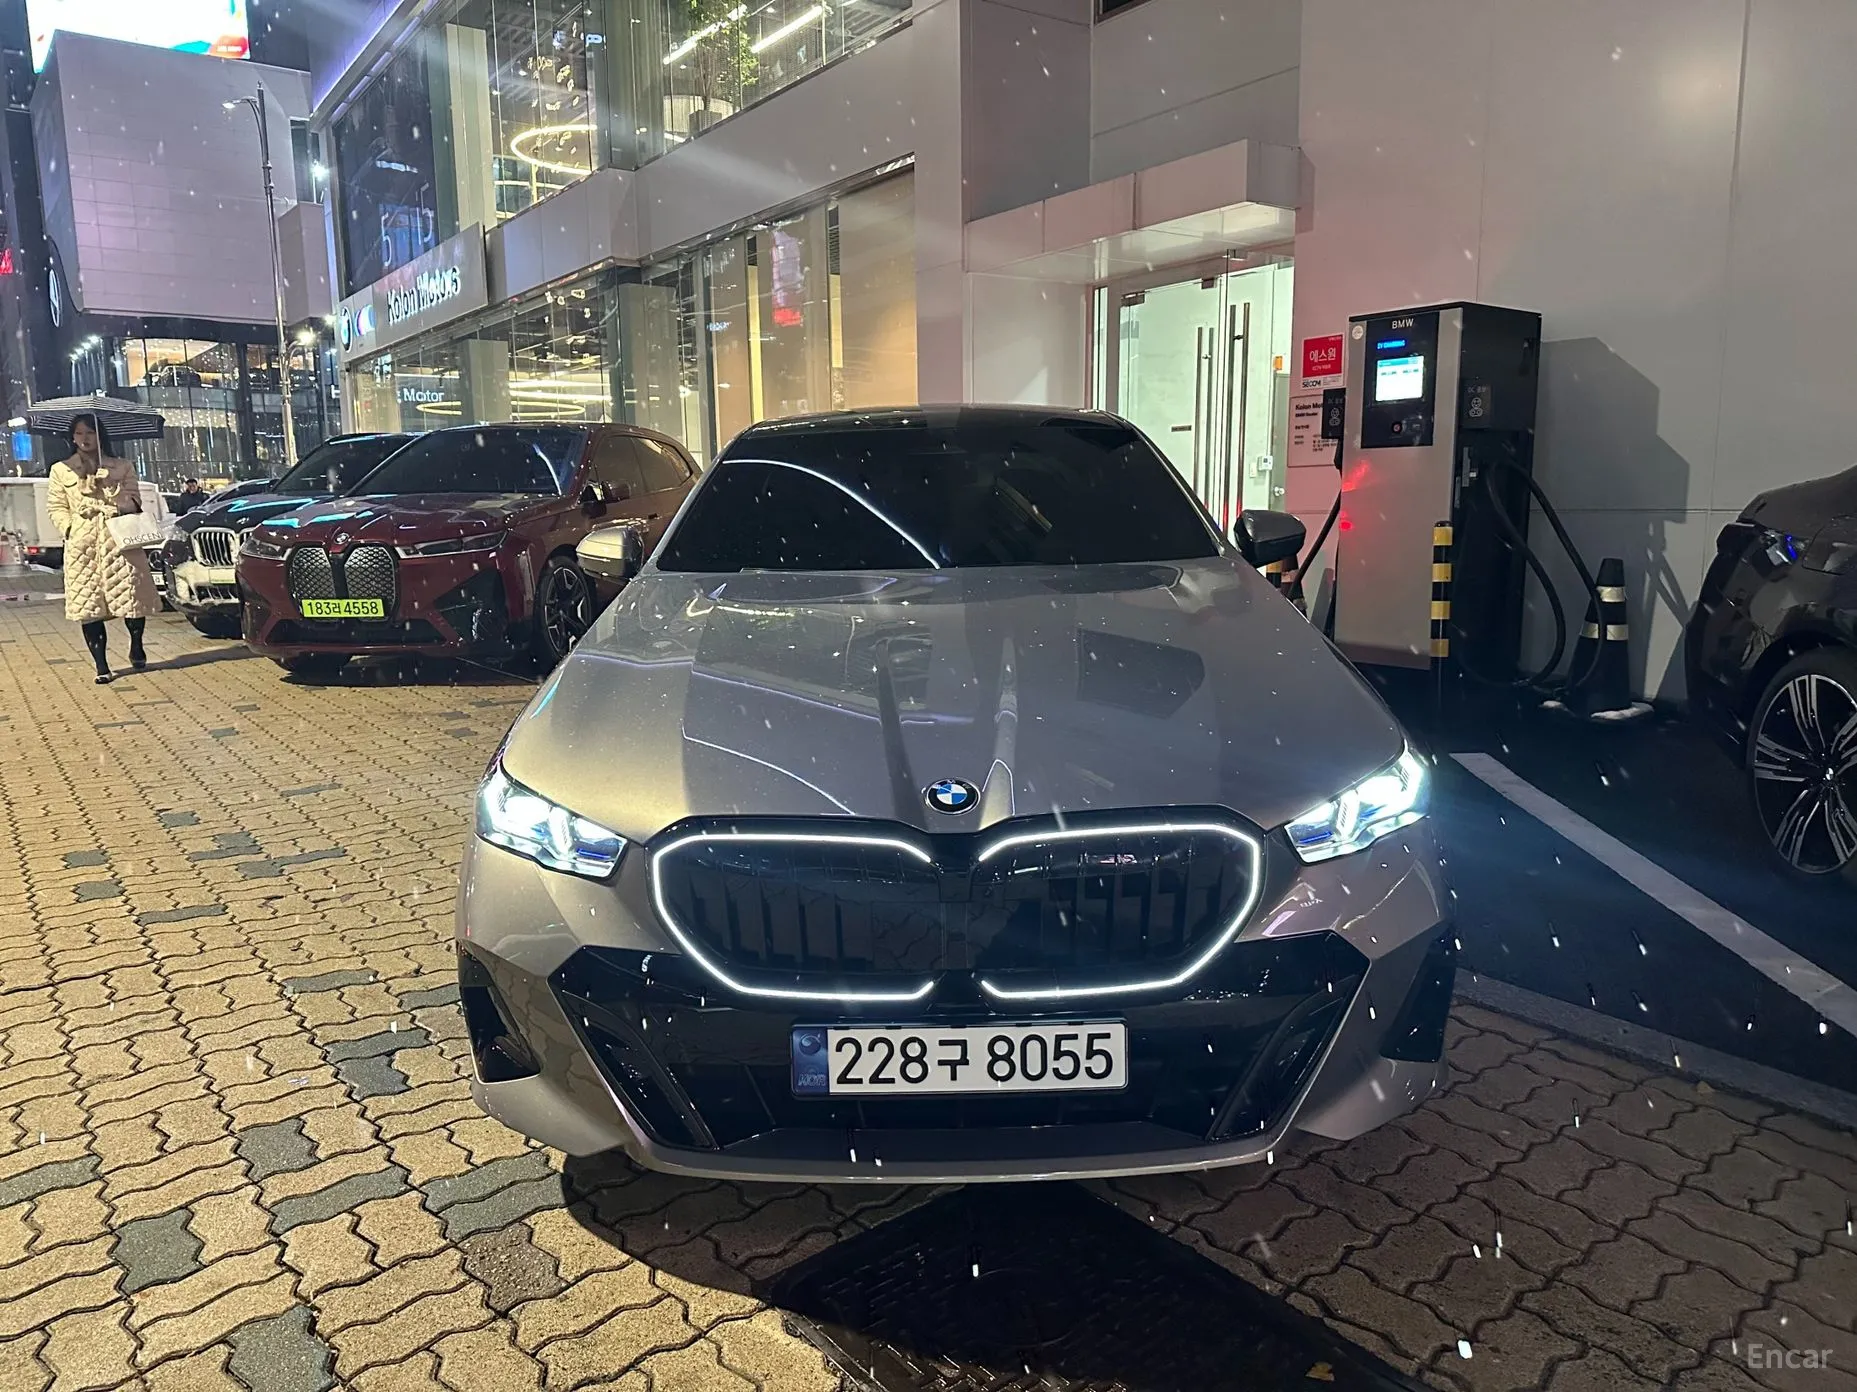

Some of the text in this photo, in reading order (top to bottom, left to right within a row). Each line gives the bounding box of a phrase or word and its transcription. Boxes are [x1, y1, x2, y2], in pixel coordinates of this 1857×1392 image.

[387, 265, 462, 327] Kolon Motors
[1391, 318, 1414, 329] BMW
[1309, 347, 1336, 363] 에스원
[403, 388, 444, 402] Motor
[343, 601, 379, 615] 4558
[835, 1032, 1114, 1085] 228구 8055
